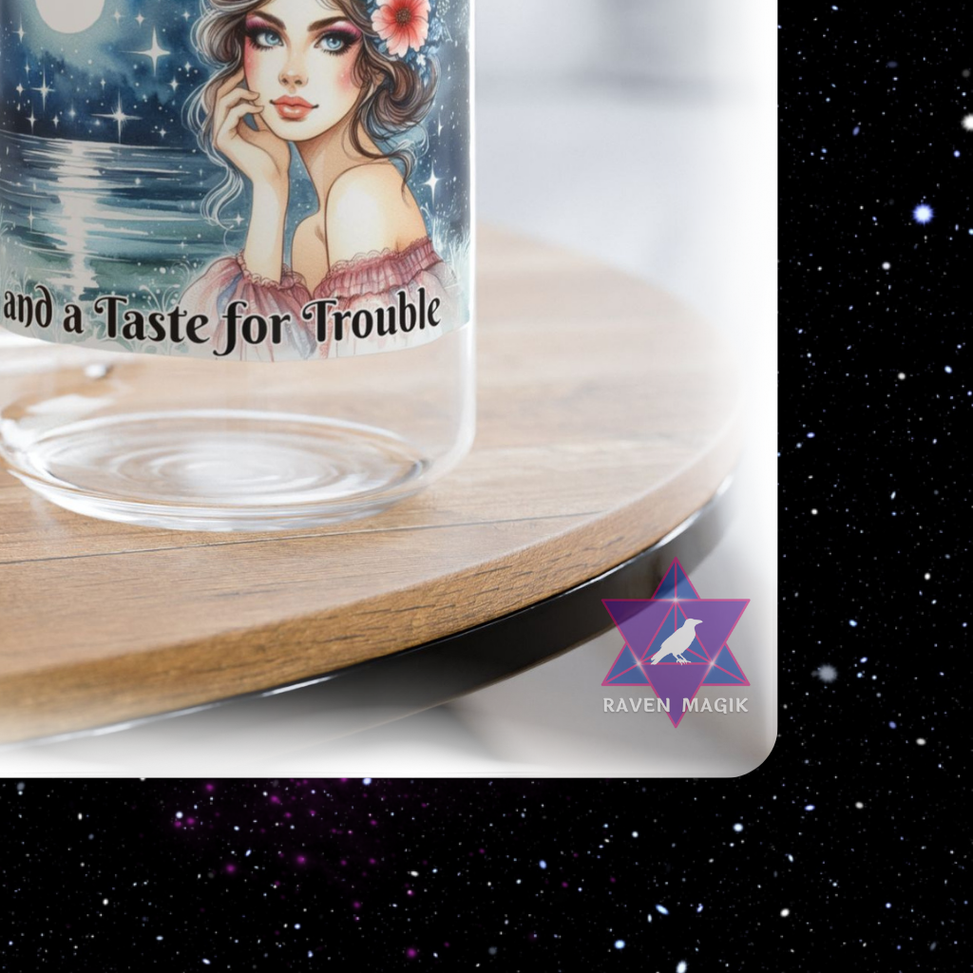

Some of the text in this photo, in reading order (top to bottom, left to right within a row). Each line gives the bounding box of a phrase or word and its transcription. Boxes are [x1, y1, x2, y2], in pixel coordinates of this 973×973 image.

[3, 285, 442, 357] and a Taste for Trouble
